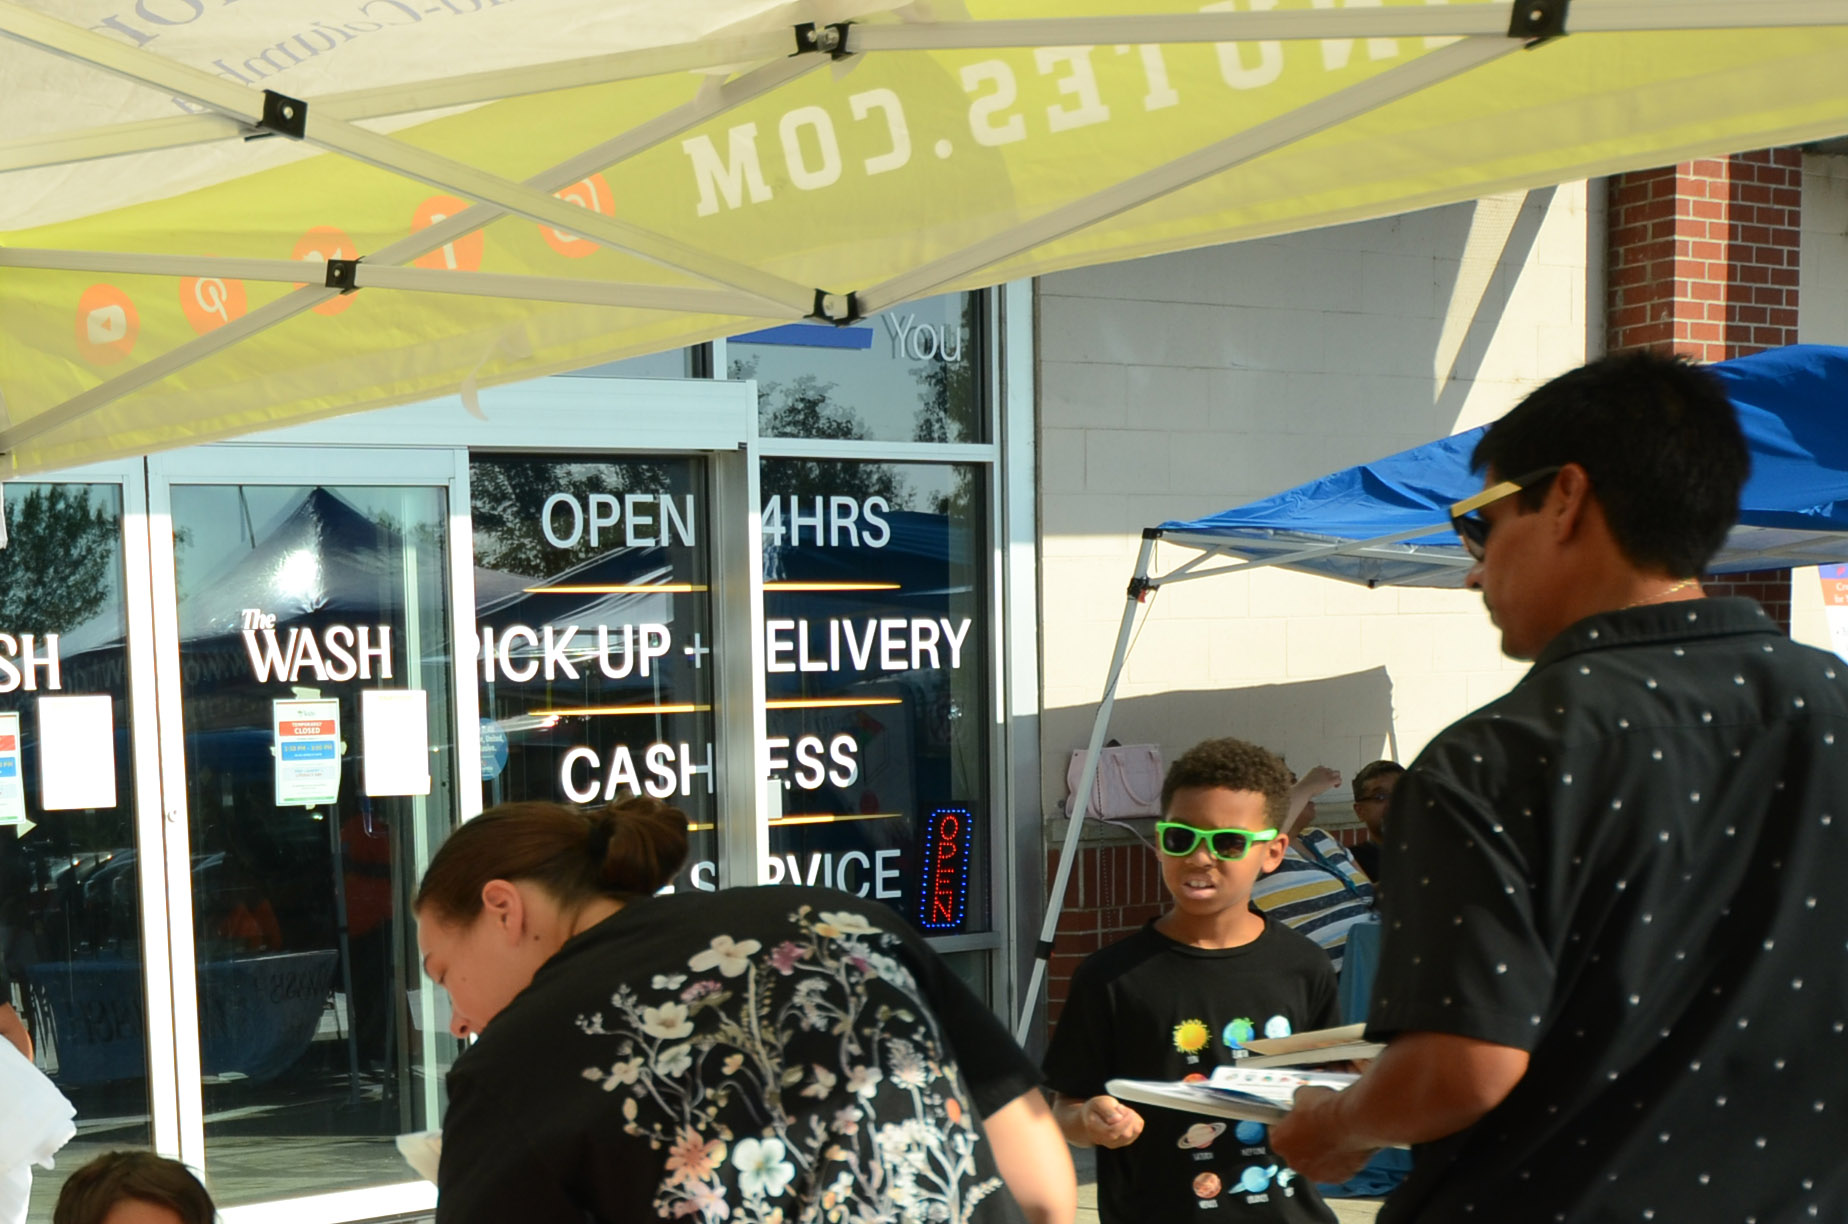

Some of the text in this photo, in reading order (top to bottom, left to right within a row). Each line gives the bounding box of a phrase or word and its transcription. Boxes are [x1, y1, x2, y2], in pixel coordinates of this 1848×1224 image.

[884, 311, 962, 363] You
[542, 493, 890, 549] OPEN 4HRS
[241, 608, 277, 631] The
[245, 625, 393, 683] WASH
[598, 623, 672, 680] UP
[765, 617, 973, 673] ELIVERY
[932, 814, 960, 924] OPEN
